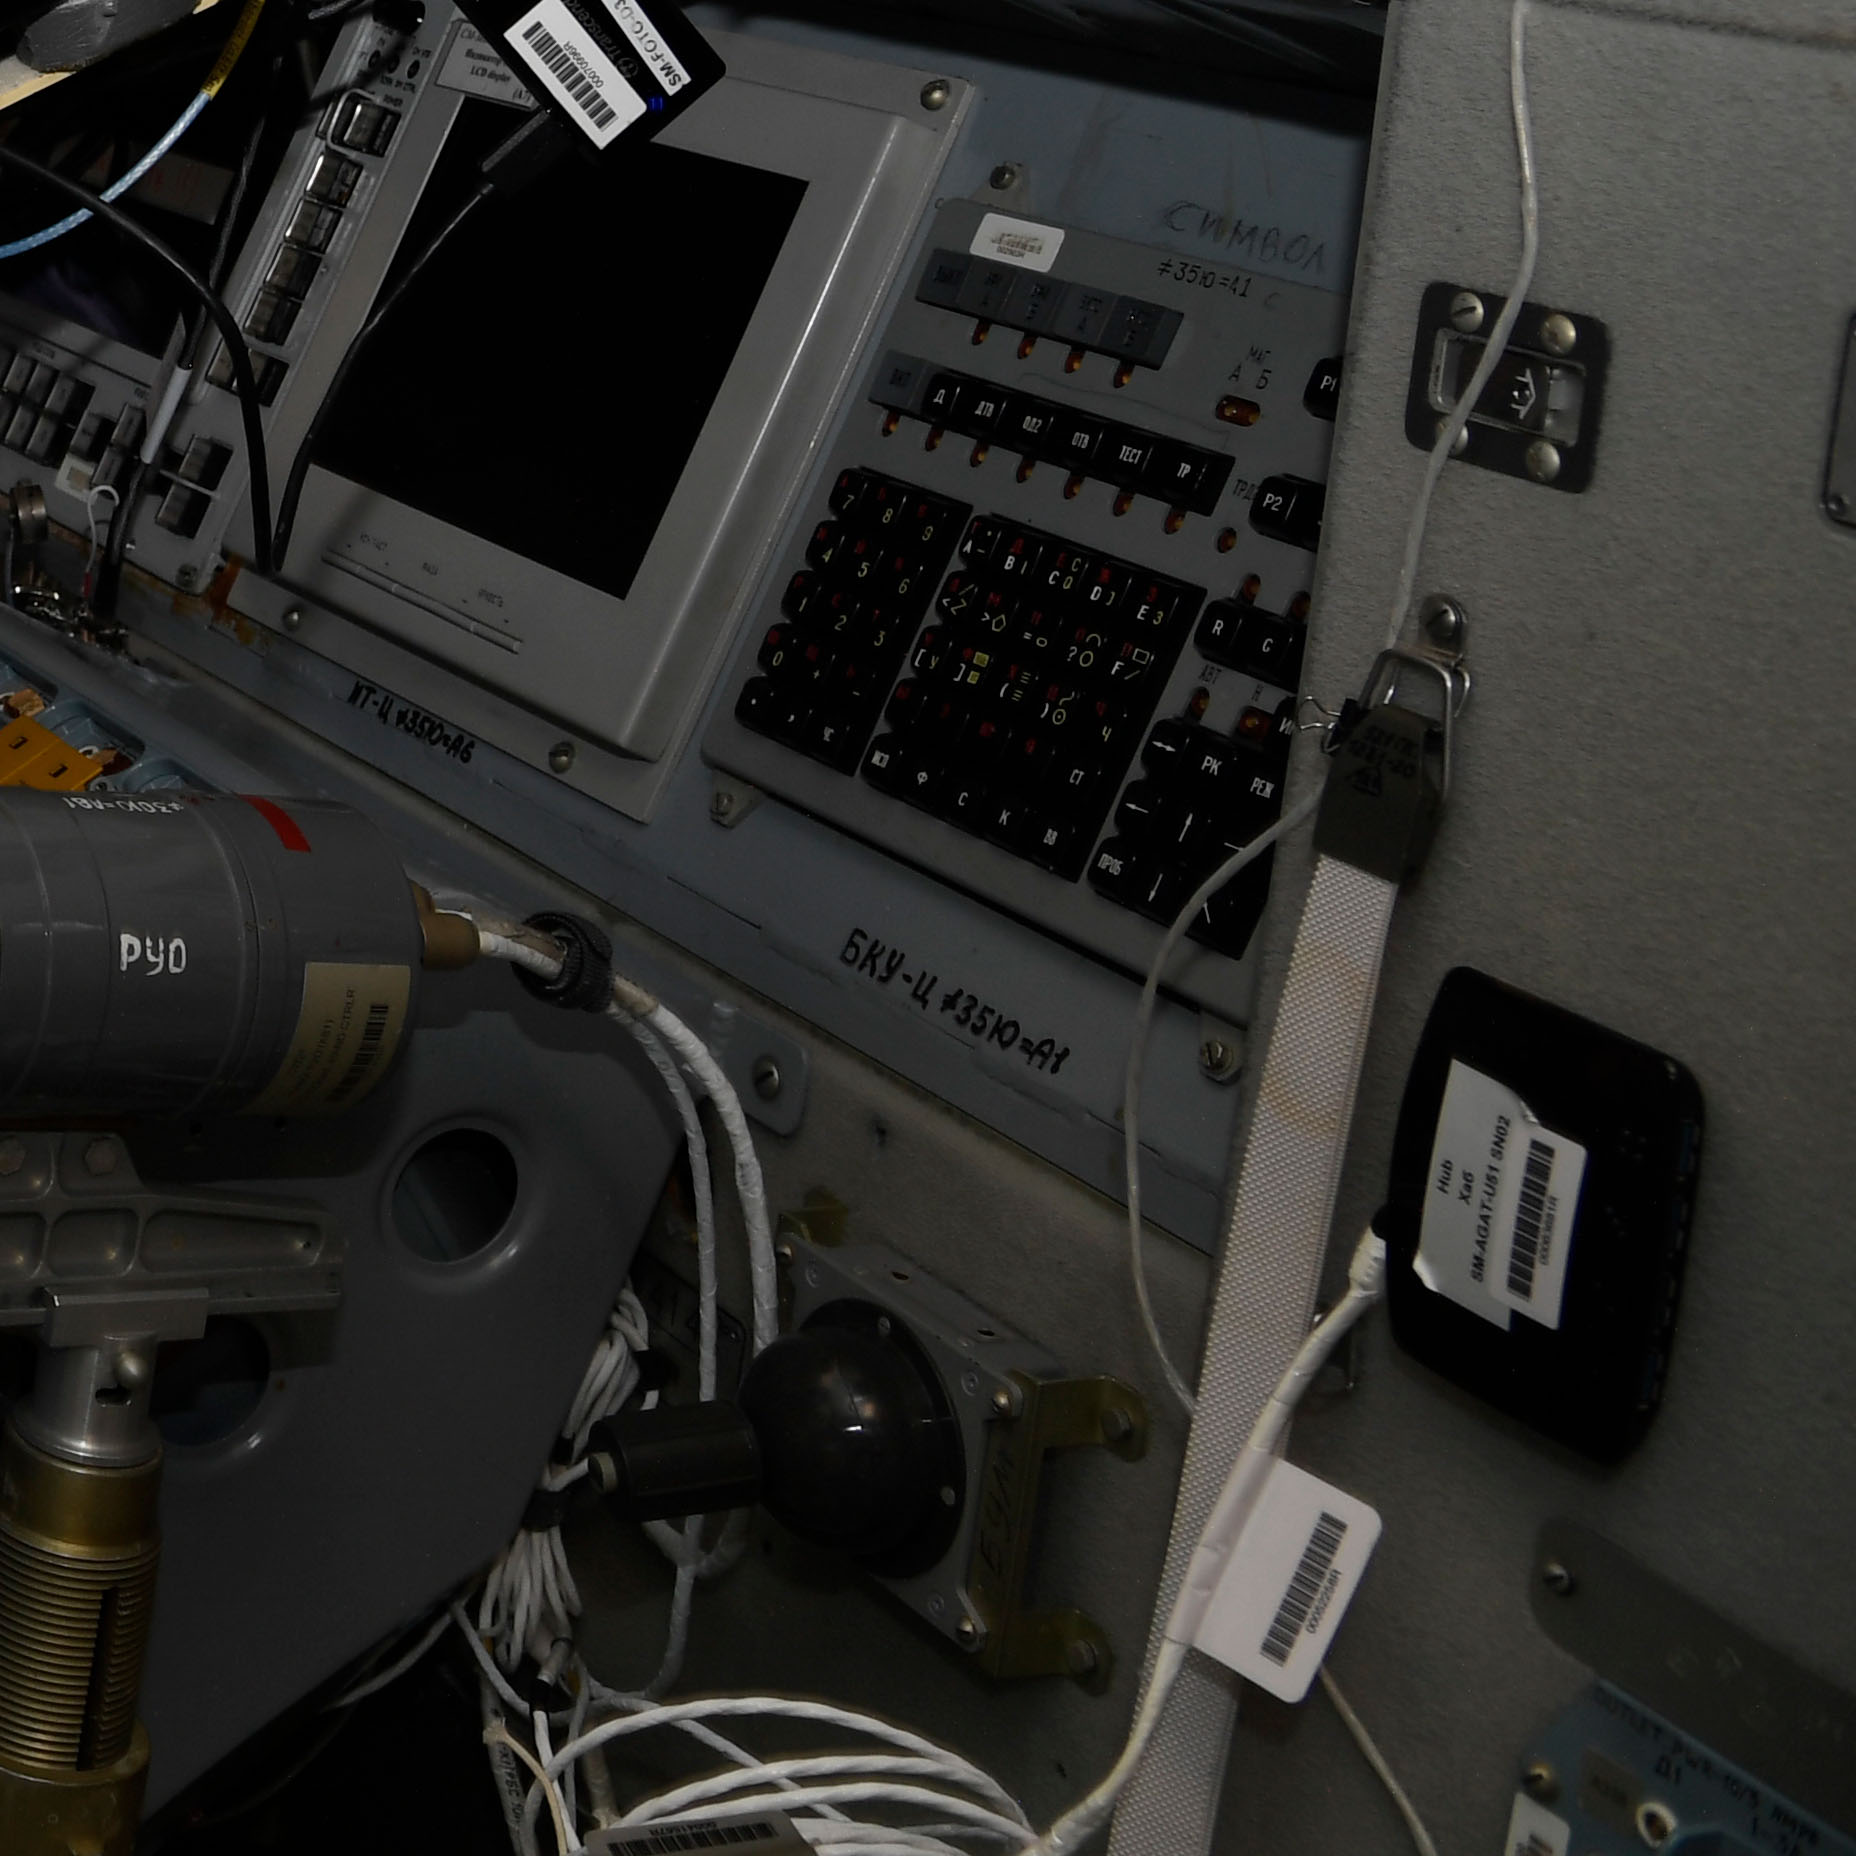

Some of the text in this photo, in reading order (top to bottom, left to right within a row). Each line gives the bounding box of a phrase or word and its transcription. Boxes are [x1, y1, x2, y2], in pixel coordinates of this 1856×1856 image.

[563, 40, 605, 90] 00070996R
[1163, 200, 1326, 275] СИМВОЛ
[1118, 443, 1144, 466] ТЕСТ
[1175, 460, 1192, 479] ТР
[841, 494, 855, 511] 7
[881, 507, 894, 524] 8
[921, 524, 934, 542] 9
[821, 547, 834, 564] 4
[857, 561, 870, 578] 5
[898, 577, 911, 594] 6
[834, 615, 848, 632] 2
[1210, 619, 1225, 638] R
[873, 630, 886, 648] 3
[772, 650, 784, 668] 0
[1110, 660, 1125, 676] F
[840, 927, 938, 1011] БКУ-Ц
[1489, 1114, 1512, 1164] SN02
[1437, 1158, 1454, 1195] Hub
